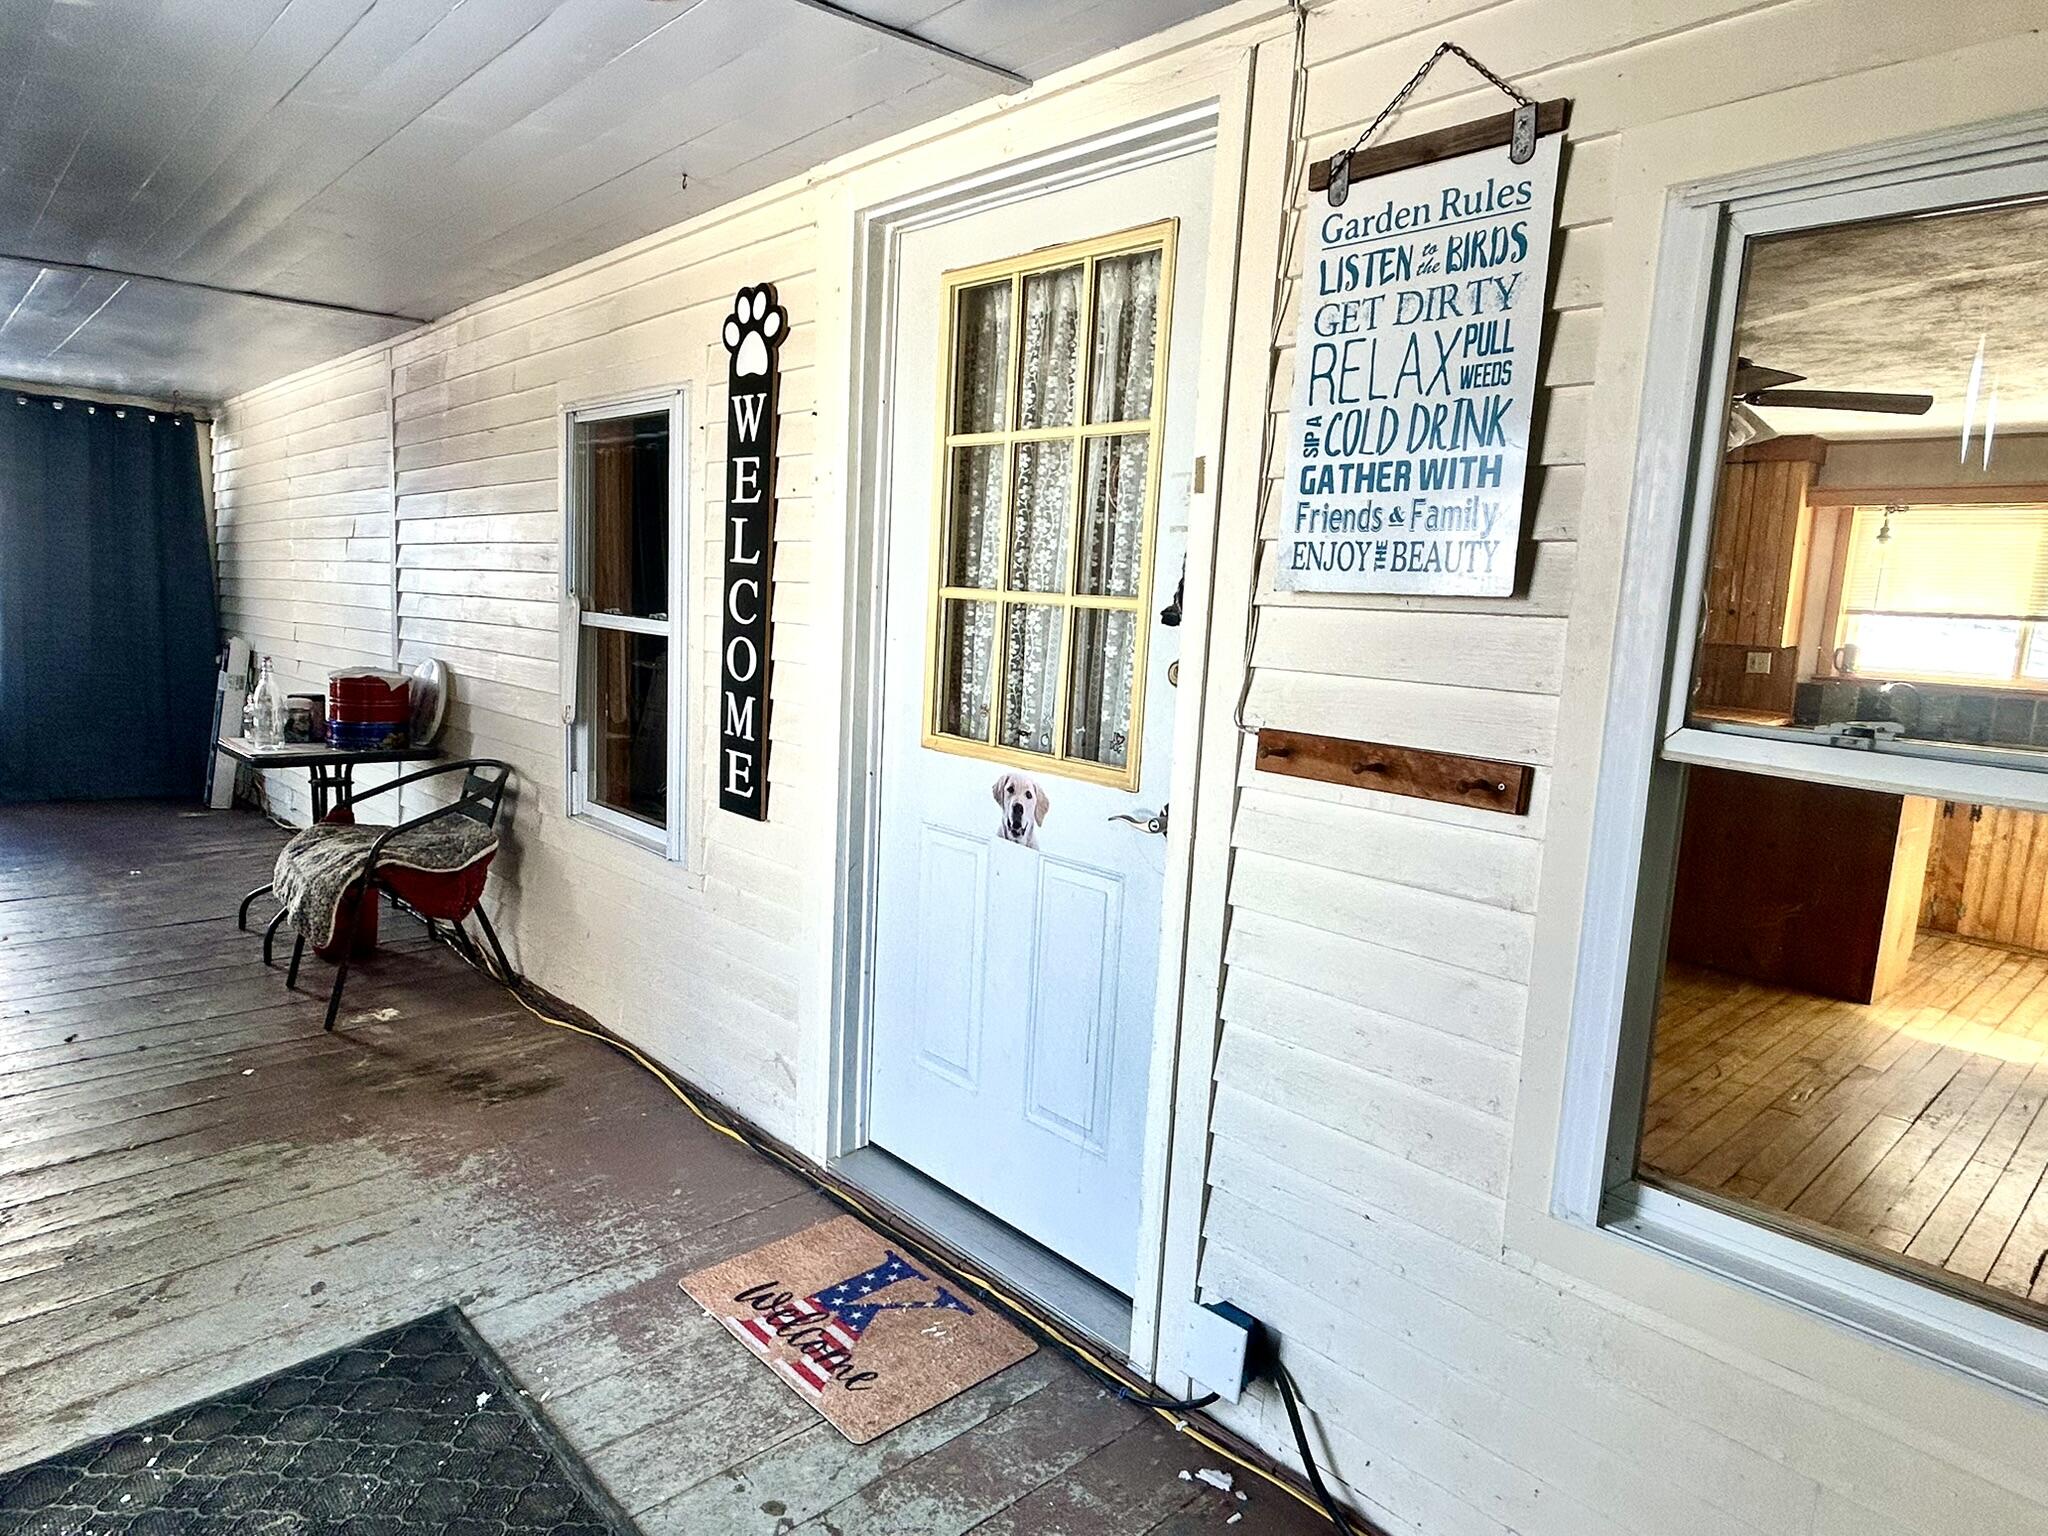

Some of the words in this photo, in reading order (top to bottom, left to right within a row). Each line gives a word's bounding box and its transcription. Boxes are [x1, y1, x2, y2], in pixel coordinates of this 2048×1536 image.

[1321, 201, 1431, 244] Garden
[1440, 179, 1532, 220] Rules
[1416, 258, 1440, 276] the
[1422, 243, 1438, 256] to
[1445, 221, 1528, 274] BIRDS
[1319, 244, 1413, 296] LISTEN
[1314, 294, 1385, 337] GET
[1393, 272, 1521, 325] DIRTY
[1463, 319, 1514, 358] PULL
[1309, 327, 1462, 407] RELAX
[1460, 361, 1512, 390] WEEDS
[1307, 416, 1322, 427] A
[1324, 405, 1399, 458] COLD
[1406, 394, 1514, 453] DRINK
[1303, 433, 1319, 458] SIP
[1300, 459, 1411, 495] GATHER
[1419, 455, 1502, 490] WITH
[1295, 500, 1383, 534] Friends
[1410, 496, 1499, 539] Family
[1291, 541, 1373, 572] ENJOY
[1374, 540, 1389, 570] THE
[1390, 540, 1500, 573] BEAUTY
[725, 393, 767, 798] WELCOME
